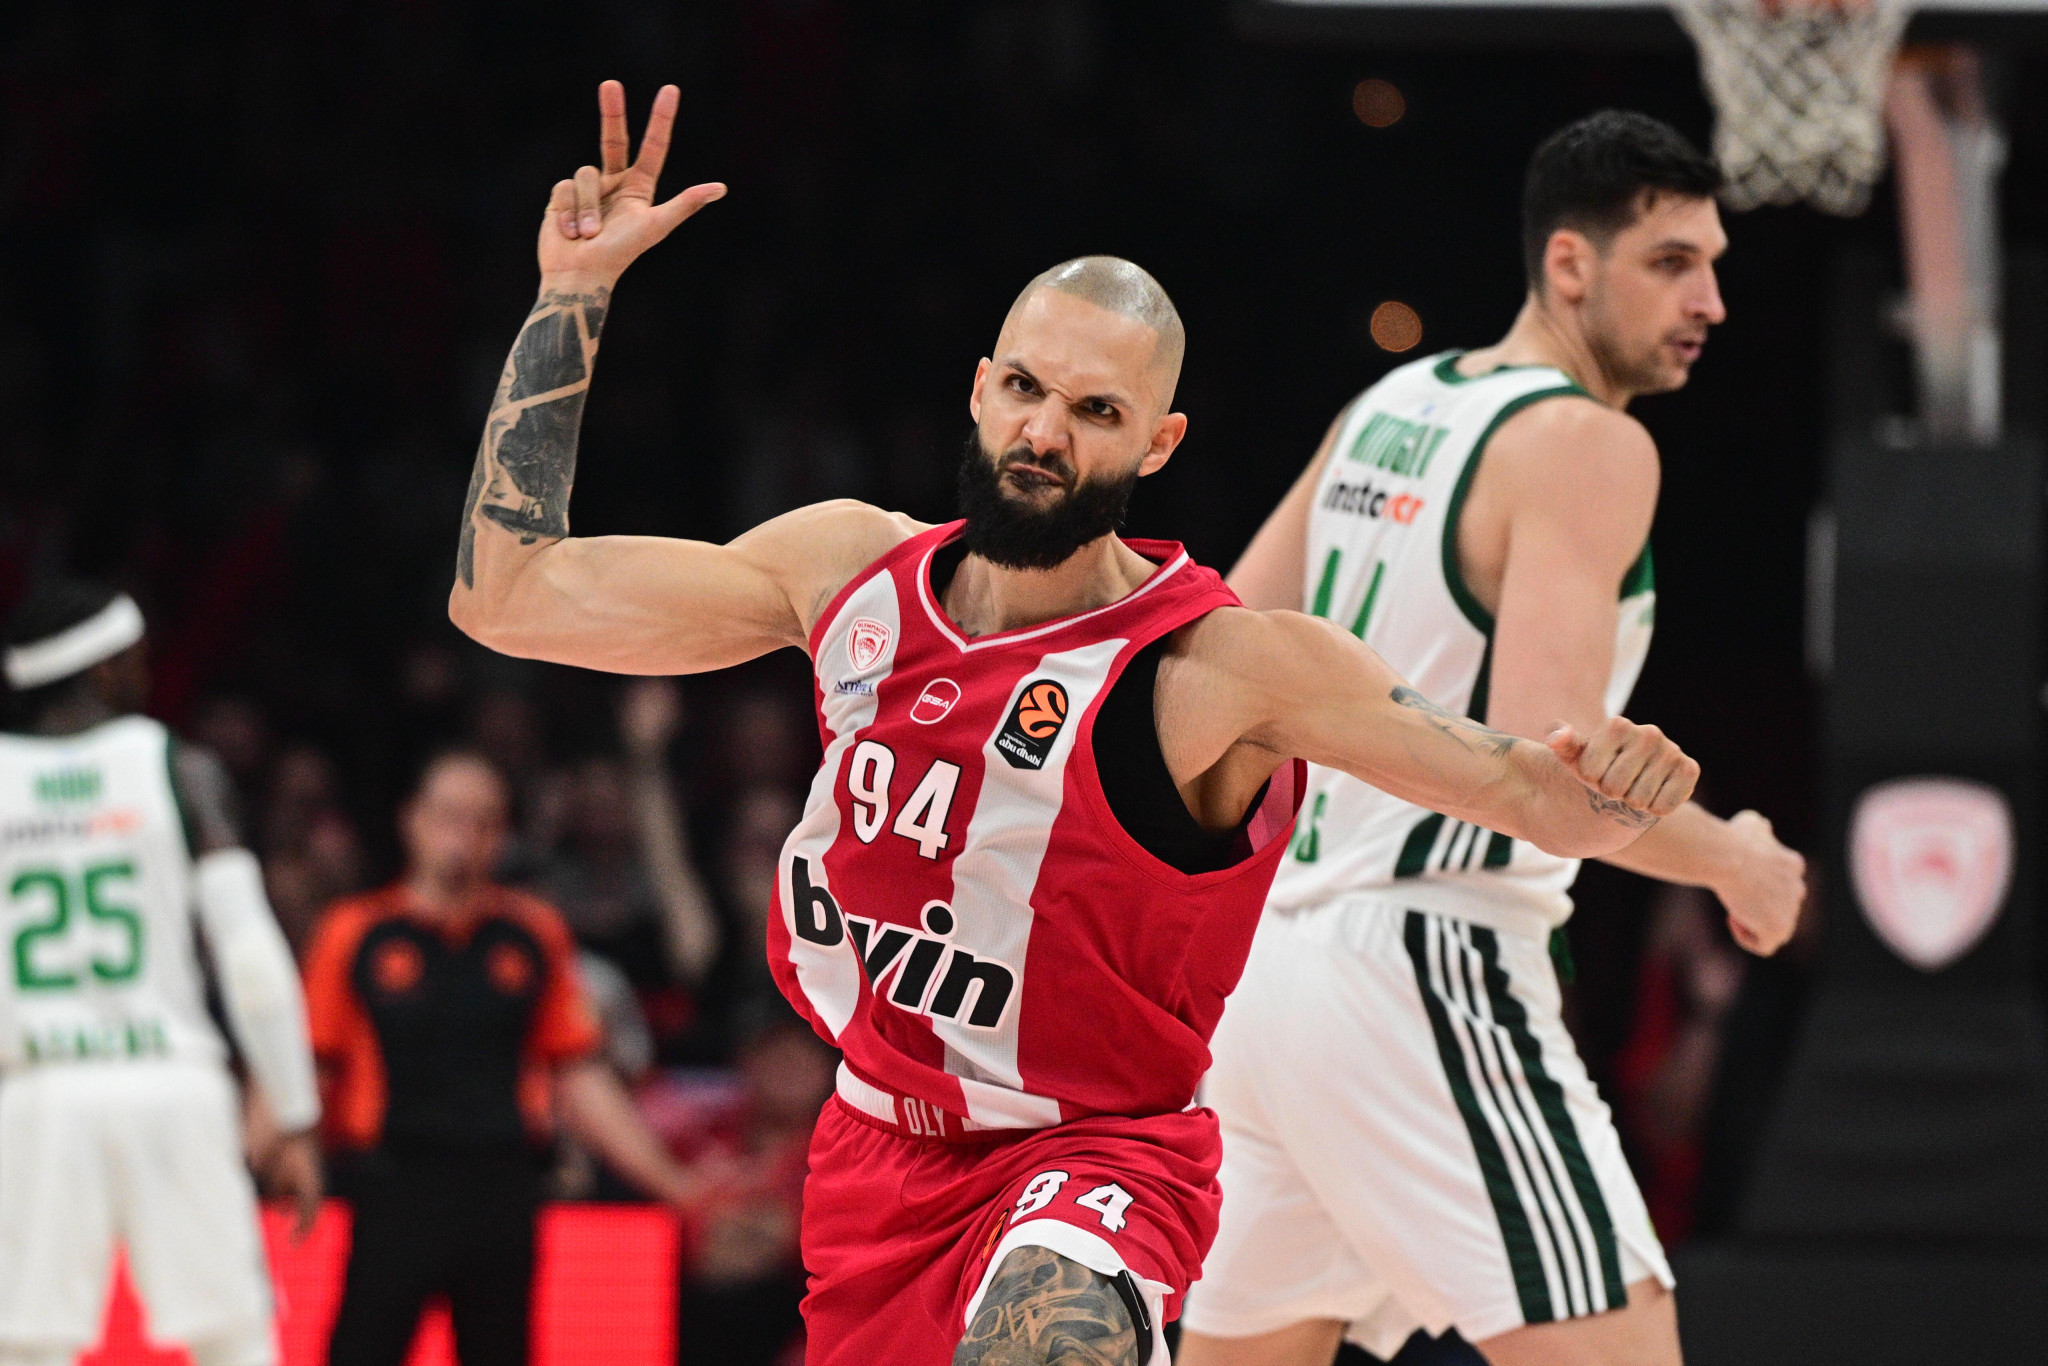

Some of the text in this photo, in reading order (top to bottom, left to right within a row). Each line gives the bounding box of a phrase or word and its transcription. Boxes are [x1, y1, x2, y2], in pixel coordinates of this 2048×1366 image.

[998, 738, 1043, 767] abu dhabi
[847, 739, 963, 861] 94
[11, 859, 143, 991] 25
[1009, 1169, 1135, 1235] 94
